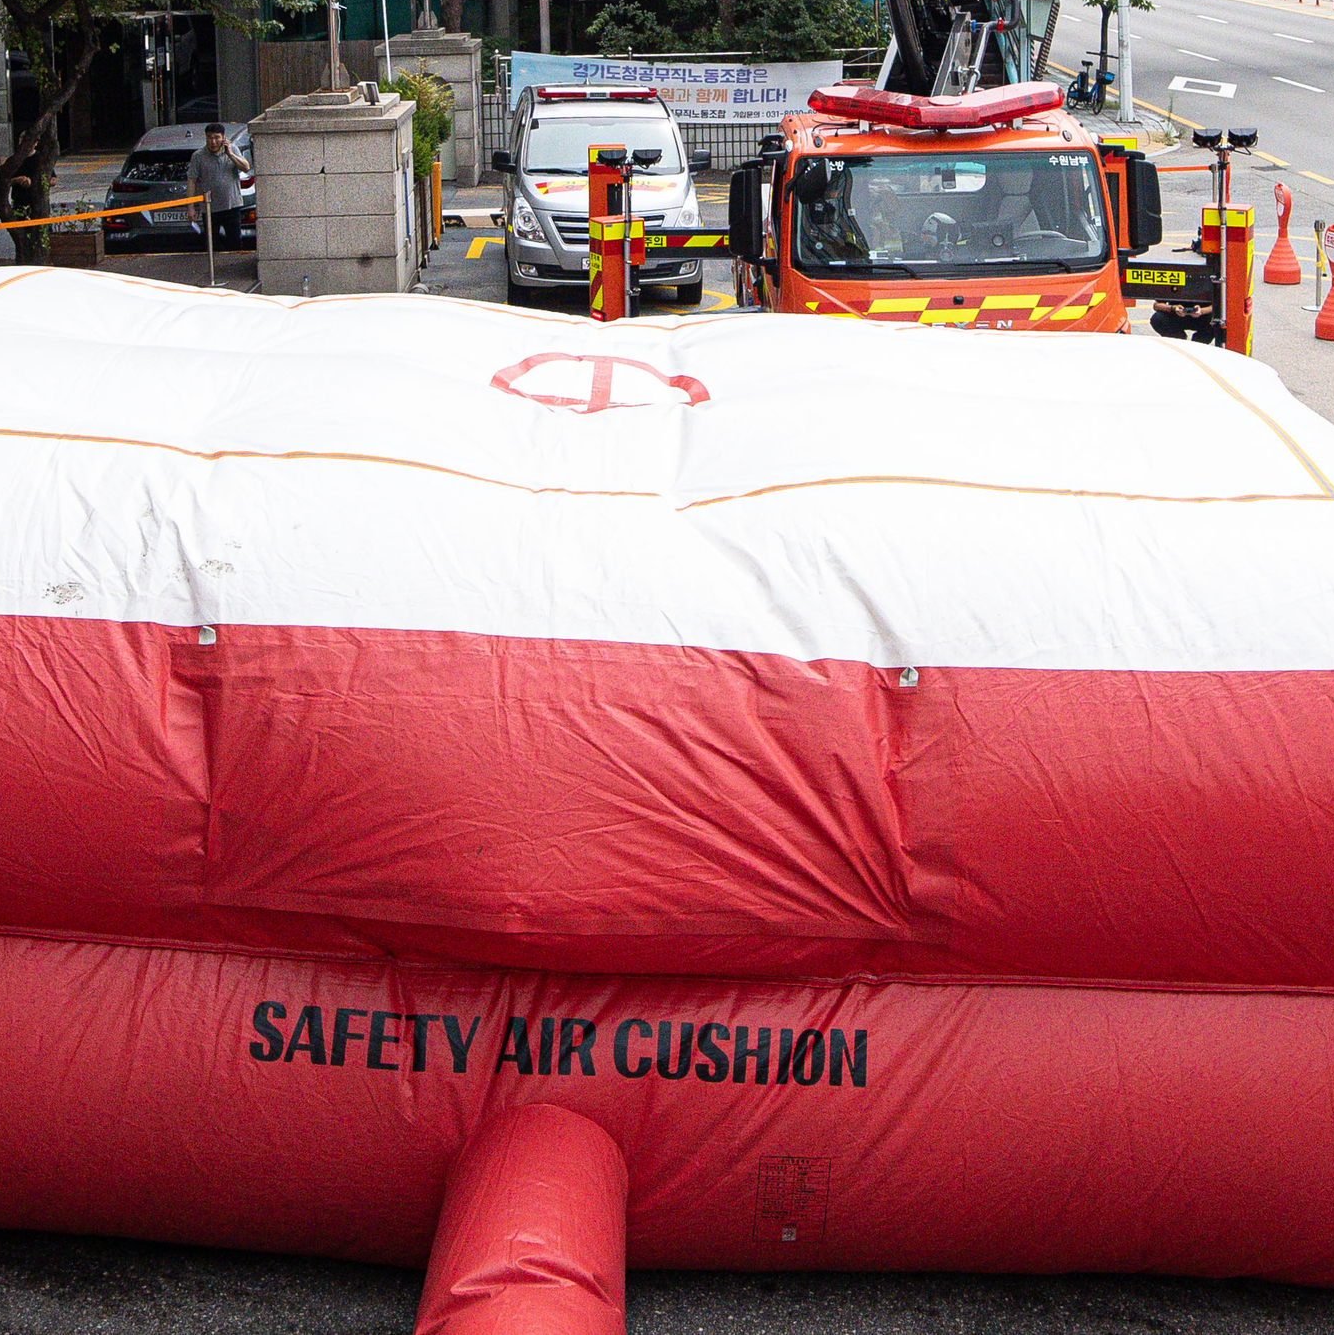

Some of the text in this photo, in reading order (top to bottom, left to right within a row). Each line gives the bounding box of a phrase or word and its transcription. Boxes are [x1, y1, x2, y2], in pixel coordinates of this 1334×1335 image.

[572, 62, 768, 84] 경기도청공무직노동조합은
[657, 87, 787, 104] 원과 함께 합니다!
[670, 109, 726, 119] 무직노동조합
[1049, 155, 1089, 167] 수원남부
[644, 236, 664, 247] 주의
[1131, 270, 1180, 284] 머리조심
[249, 1000, 868, 1088] SAFETY AIR CUSHION
